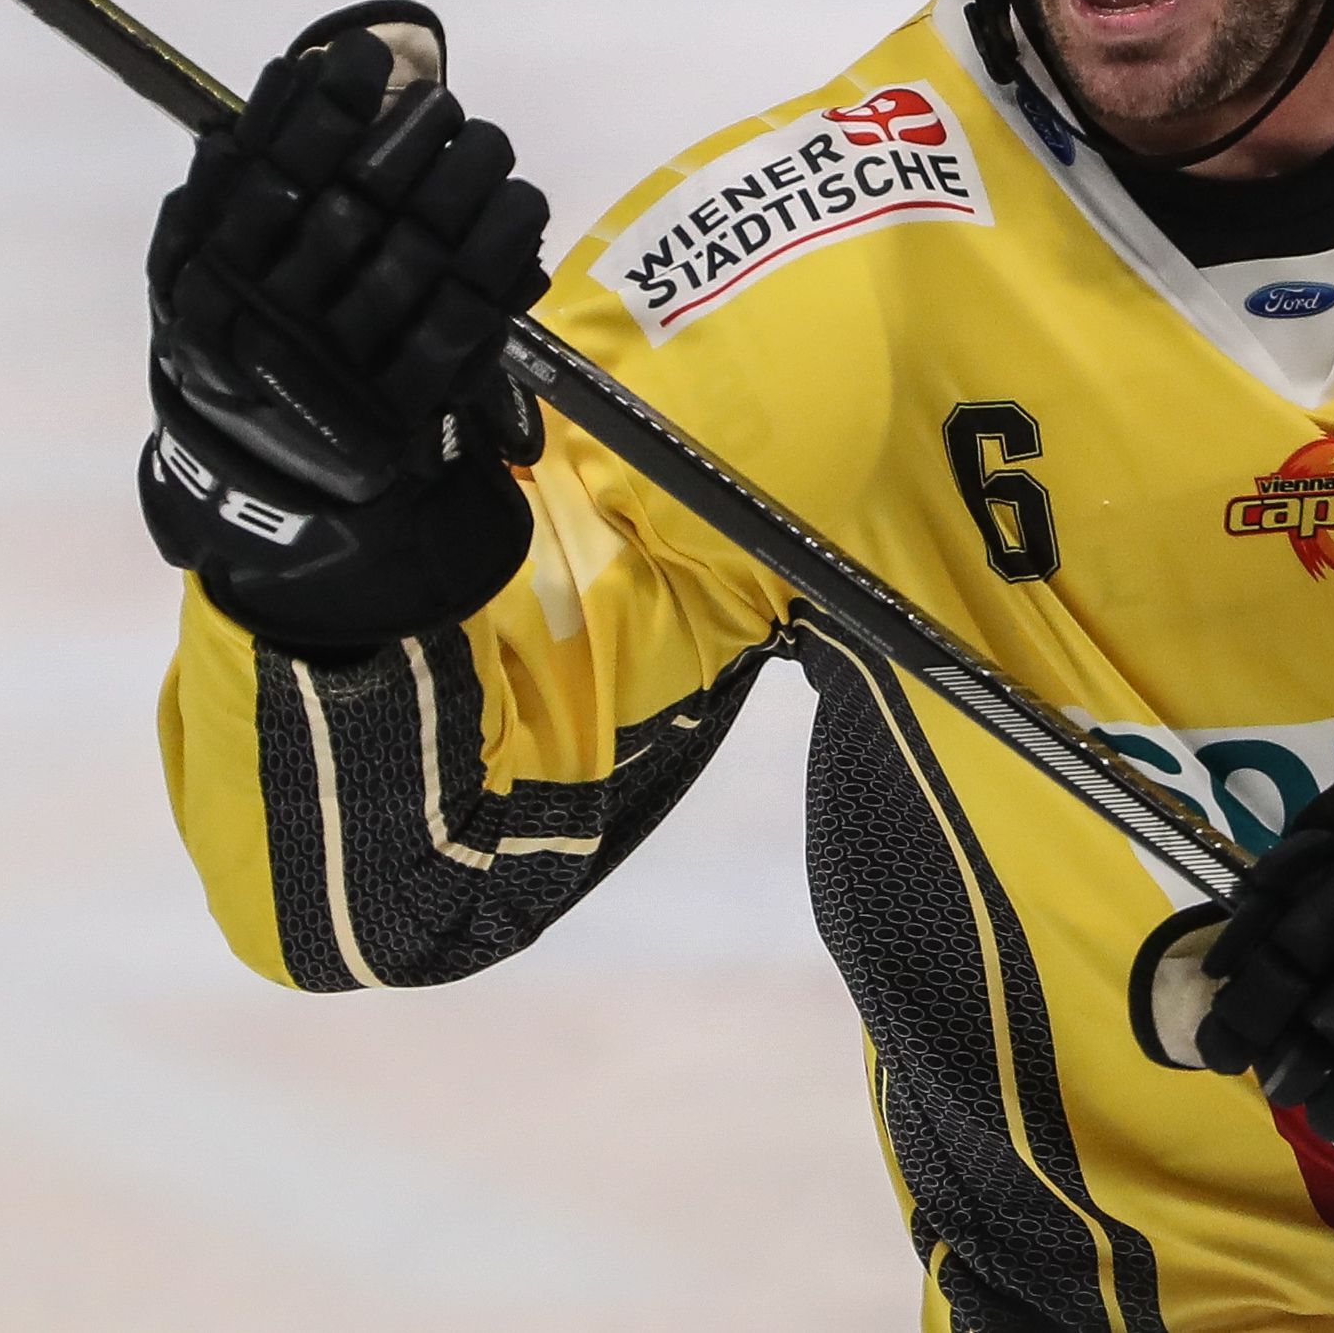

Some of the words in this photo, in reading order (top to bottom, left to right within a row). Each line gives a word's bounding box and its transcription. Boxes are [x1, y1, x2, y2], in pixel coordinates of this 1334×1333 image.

[625, 133, 845, 284] WIENER
[639, 149, 970, 309] STÄDTISCHE
[942, 399, 1061, 584] 6
